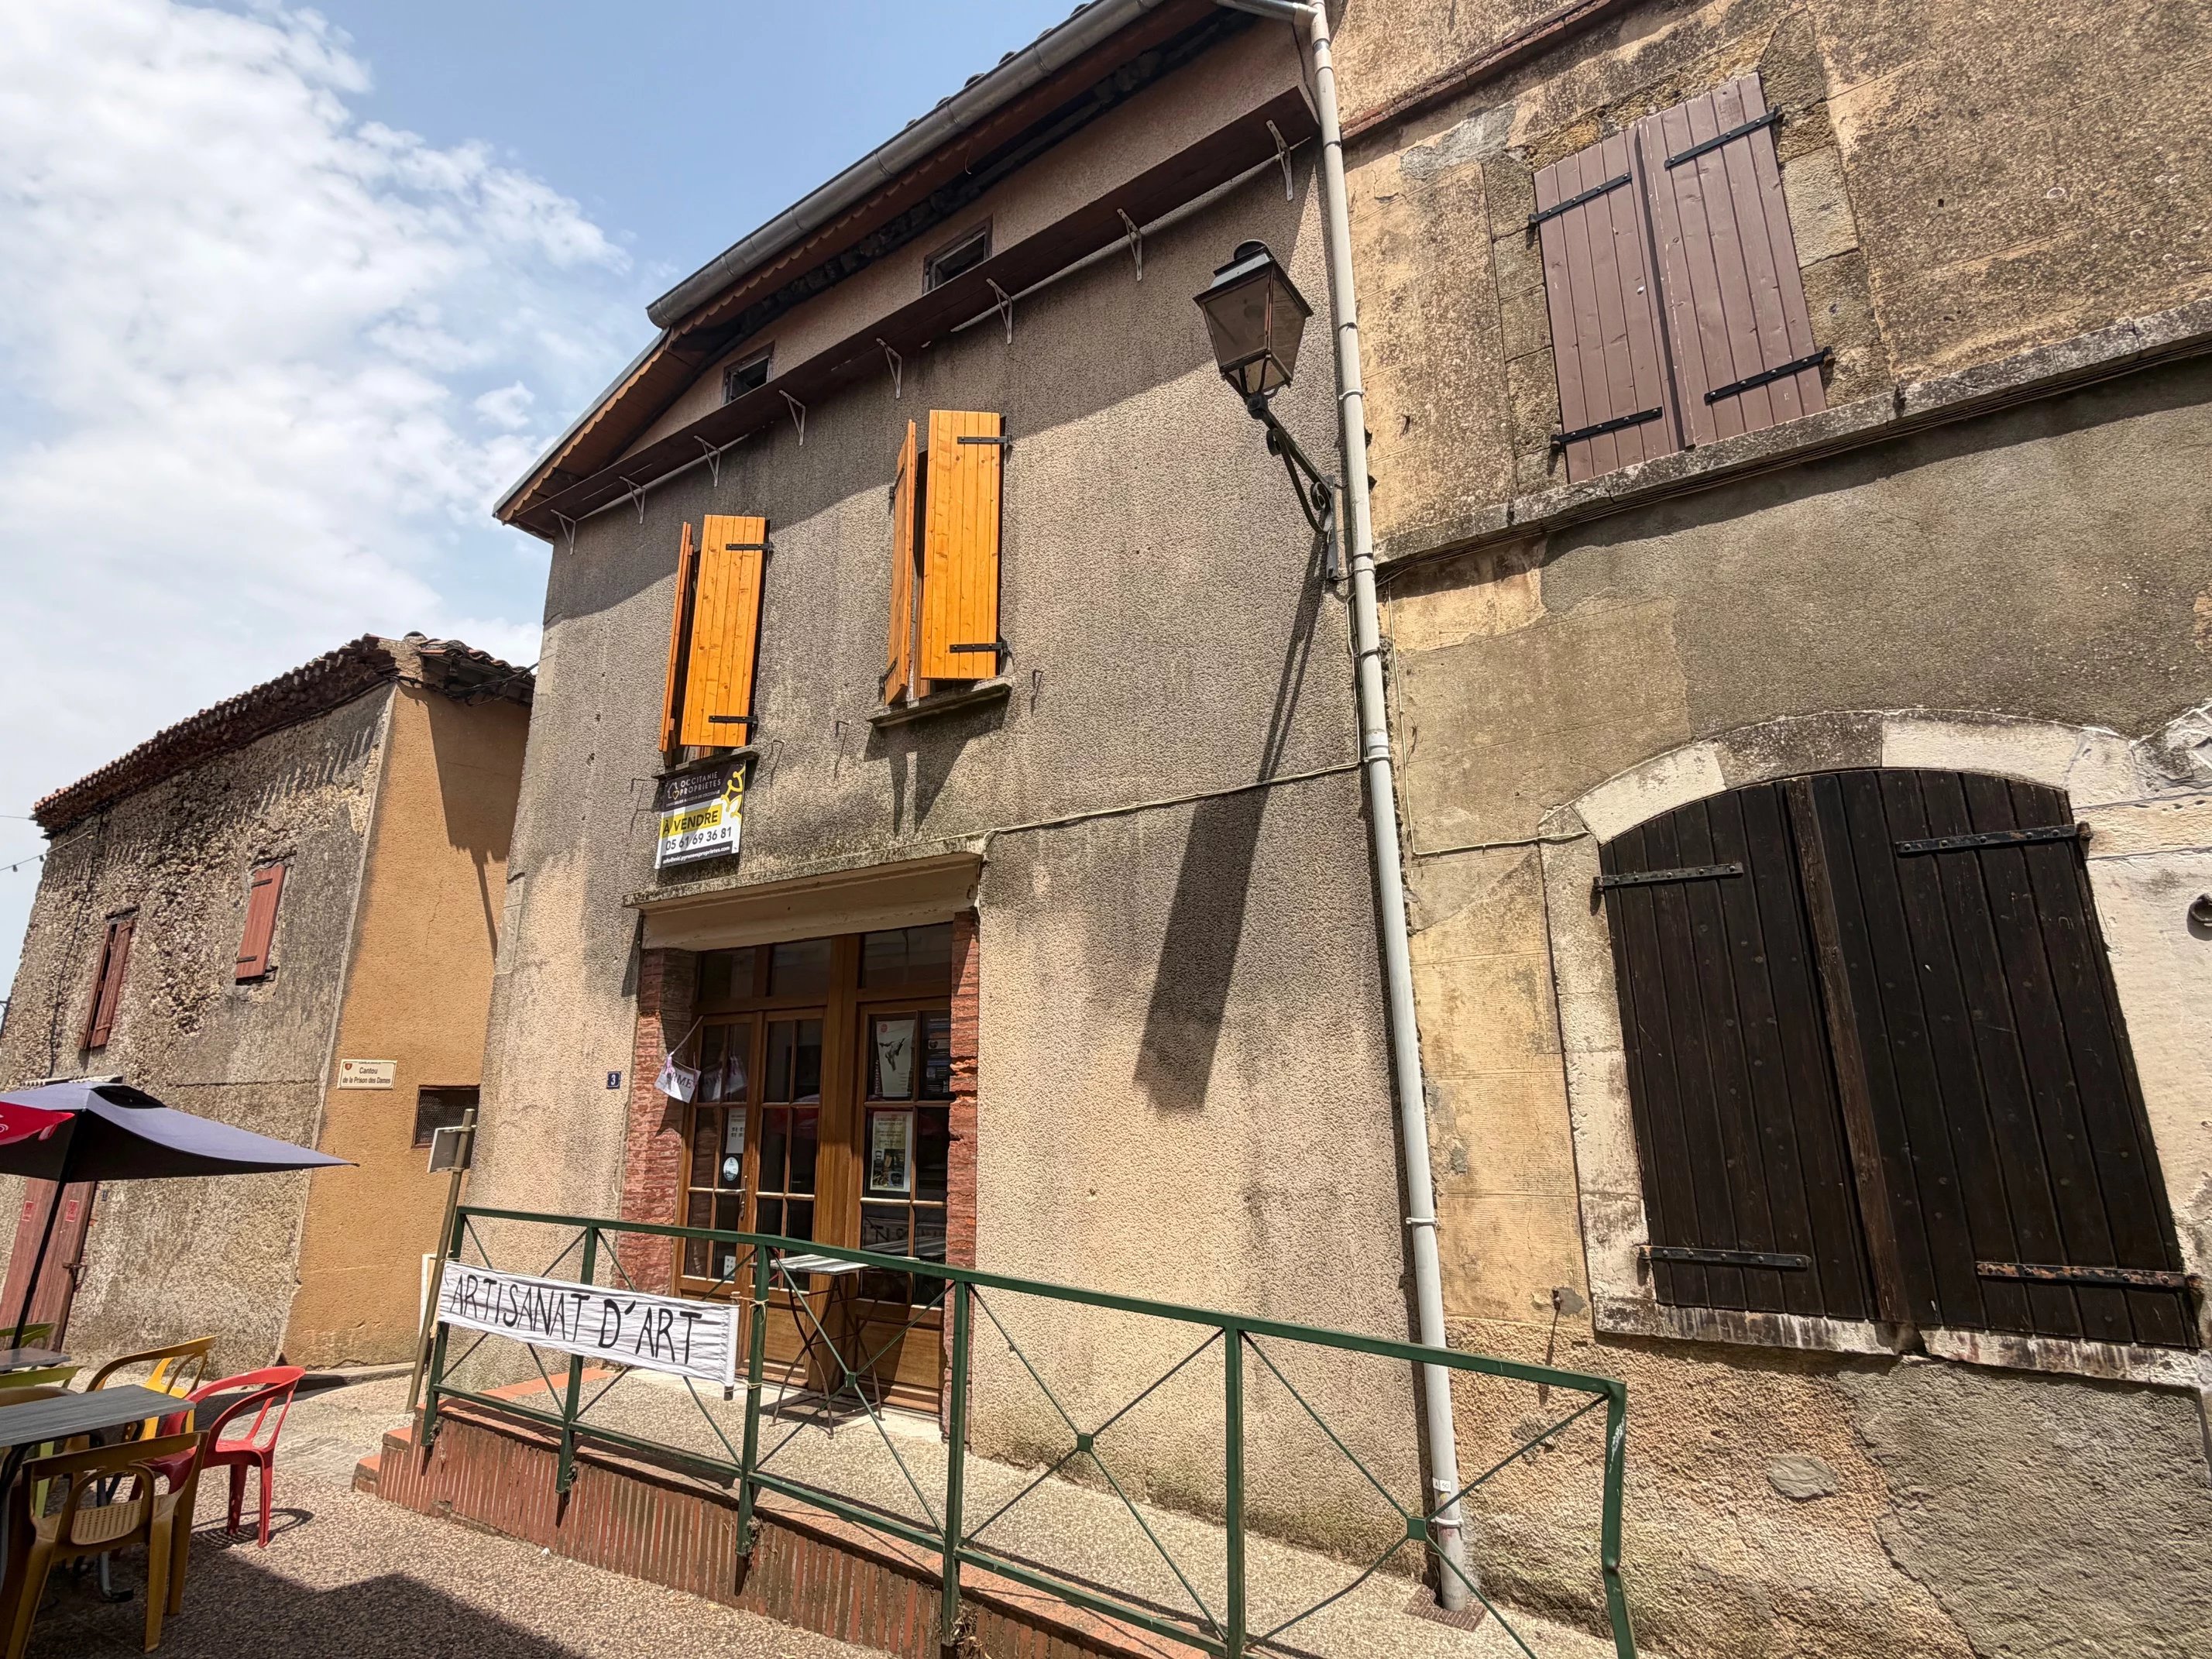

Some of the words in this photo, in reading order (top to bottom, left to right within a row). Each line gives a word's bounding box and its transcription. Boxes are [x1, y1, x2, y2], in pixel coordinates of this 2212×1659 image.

[680, 771, 718, 788] OCCITANIE
[674, 810, 719, 832] VENDRE
[665, 839, 676, 850] 05
[678, 836, 689, 848] 61
[692, 833, 703, 845] 69
[706, 830, 717, 842] 36
[720, 826, 731, 839] 81
[610, 1074, 616, 1085] 3
[449, 1273, 590, 1342] ARTISANAT
[598, 1298, 702, 1365] D'ART
